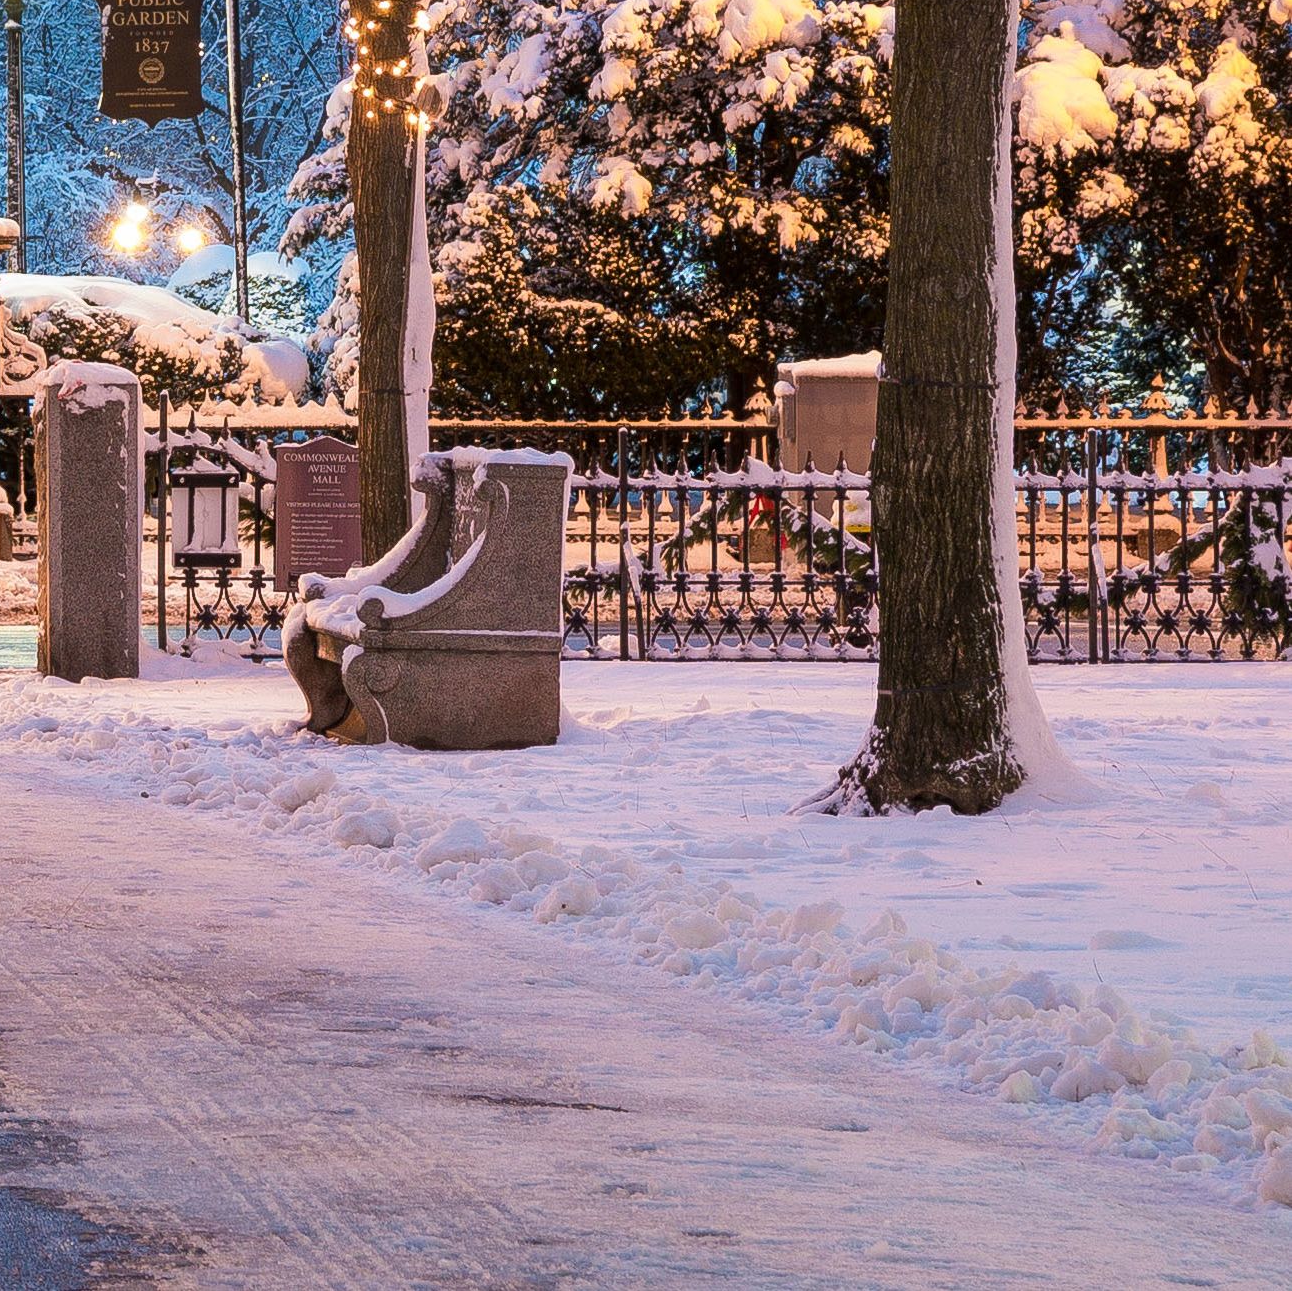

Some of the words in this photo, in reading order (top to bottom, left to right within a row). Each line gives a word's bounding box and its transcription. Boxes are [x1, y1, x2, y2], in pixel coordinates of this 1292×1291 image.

[112, 10, 189, 26] GARDEN
[136, 37, 170, 54] 1837
[283, 453, 360, 463] COMMONWEAL
[307, 464, 346, 474] AVENUE
[312, 475, 342, 484] MALL
